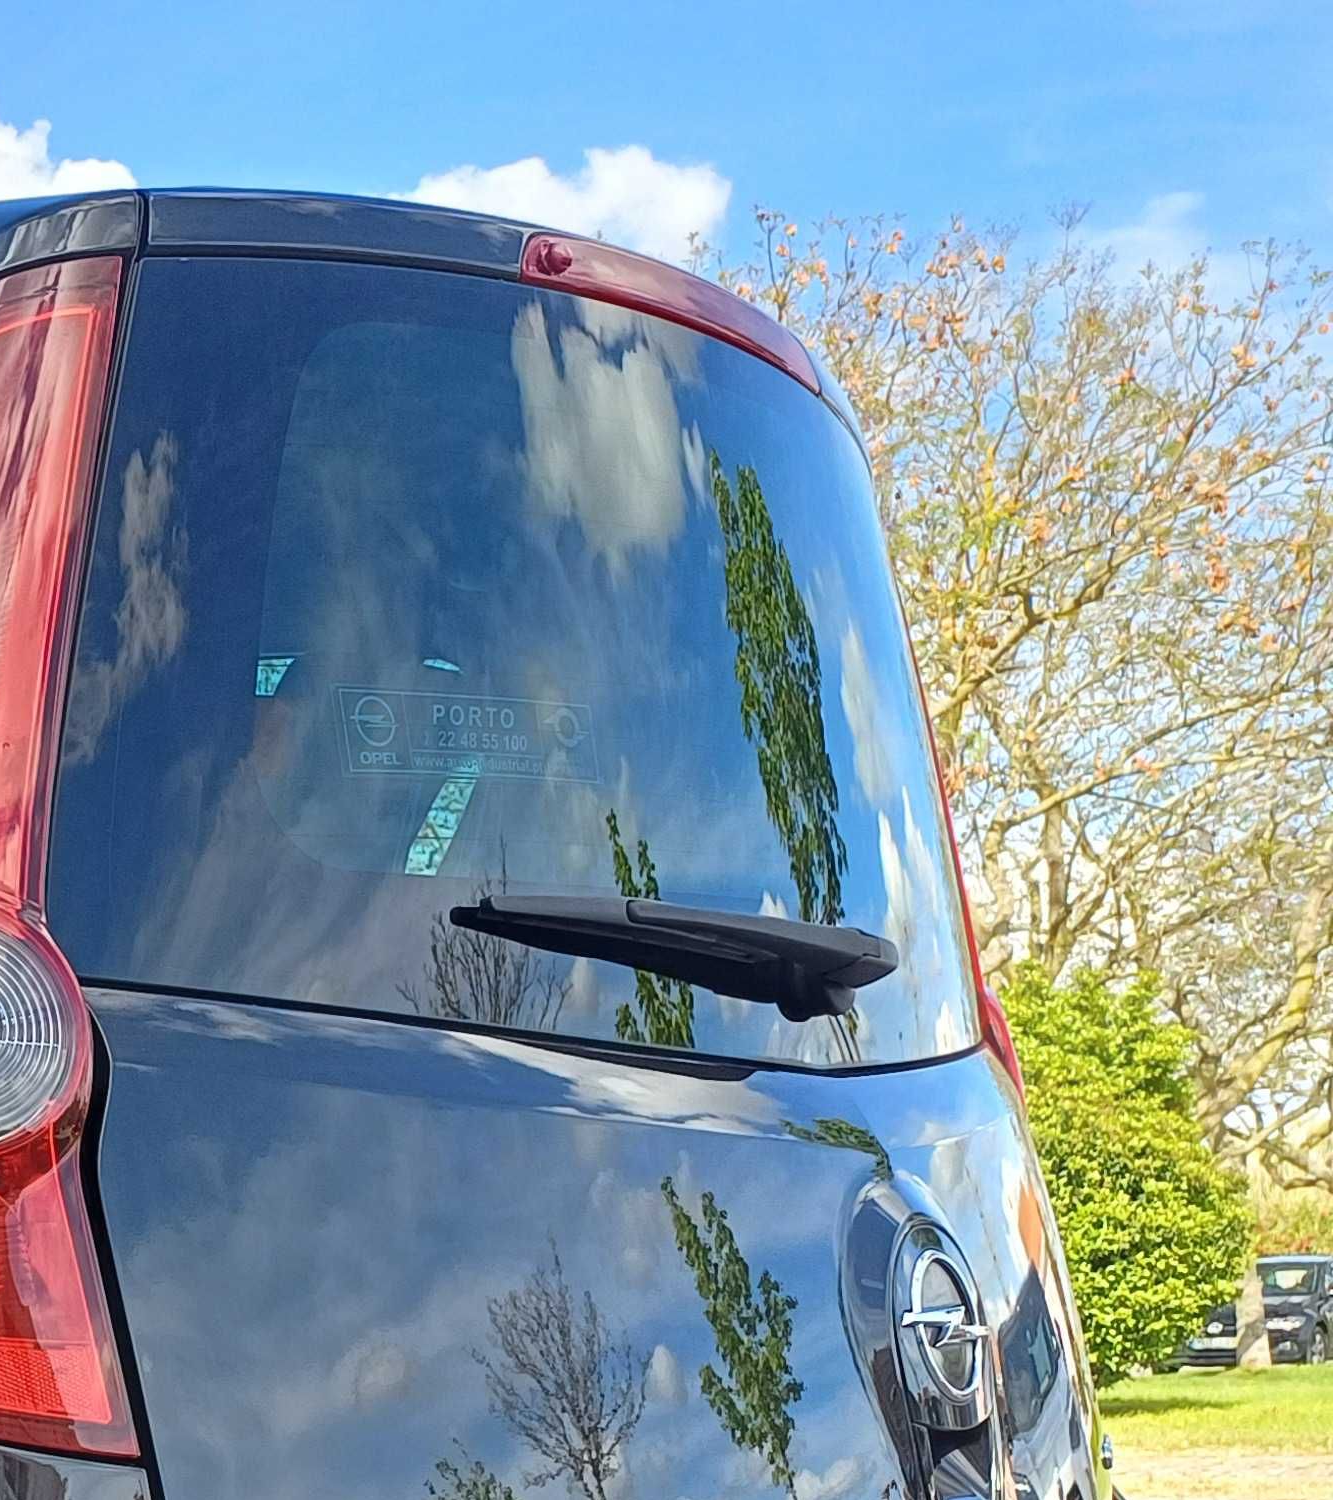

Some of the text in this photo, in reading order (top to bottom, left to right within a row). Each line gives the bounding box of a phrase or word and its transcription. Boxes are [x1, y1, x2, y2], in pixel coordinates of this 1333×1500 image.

[433, 704, 515, 729] PORTO
[438, 731, 455, 747] 22
[460, 732, 477, 749] 48
[481, 733, 498, 749] 55
[503, 735, 527, 751] 100
[360, 751, 404, 765] OPEL
